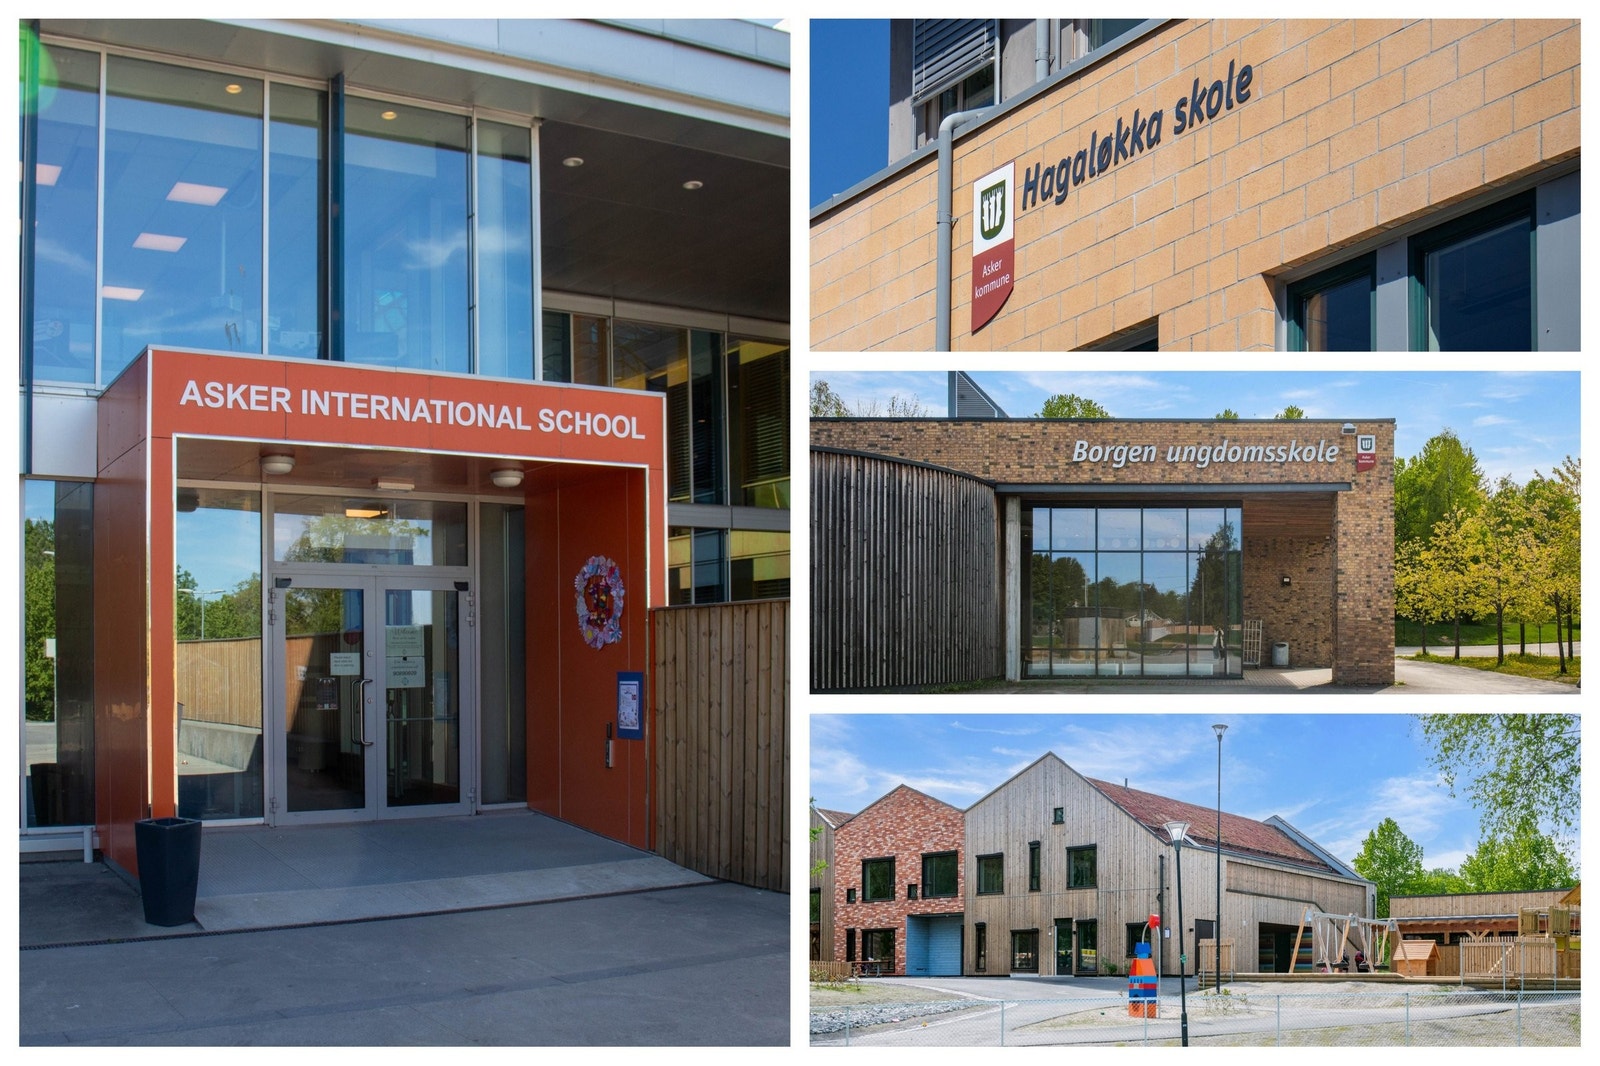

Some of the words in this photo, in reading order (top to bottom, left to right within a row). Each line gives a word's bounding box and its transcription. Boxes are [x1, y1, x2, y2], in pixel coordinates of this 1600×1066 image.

[1022, 108, 1163, 211] Hagaløkka
[1174, 59, 1253, 135] skole
[982, 259, 1003, 278] Asker
[975, 273, 1010, 299] kommune
[179, 380, 293, 413] ASKER
[301, 389, 532, 431] INTERNATIONAL
[538, 408, 646, 440] SCHOOL
[1072, 440, 1157, 468] Borgen
[1166, 440, 1339, 468] ungdomsskole
